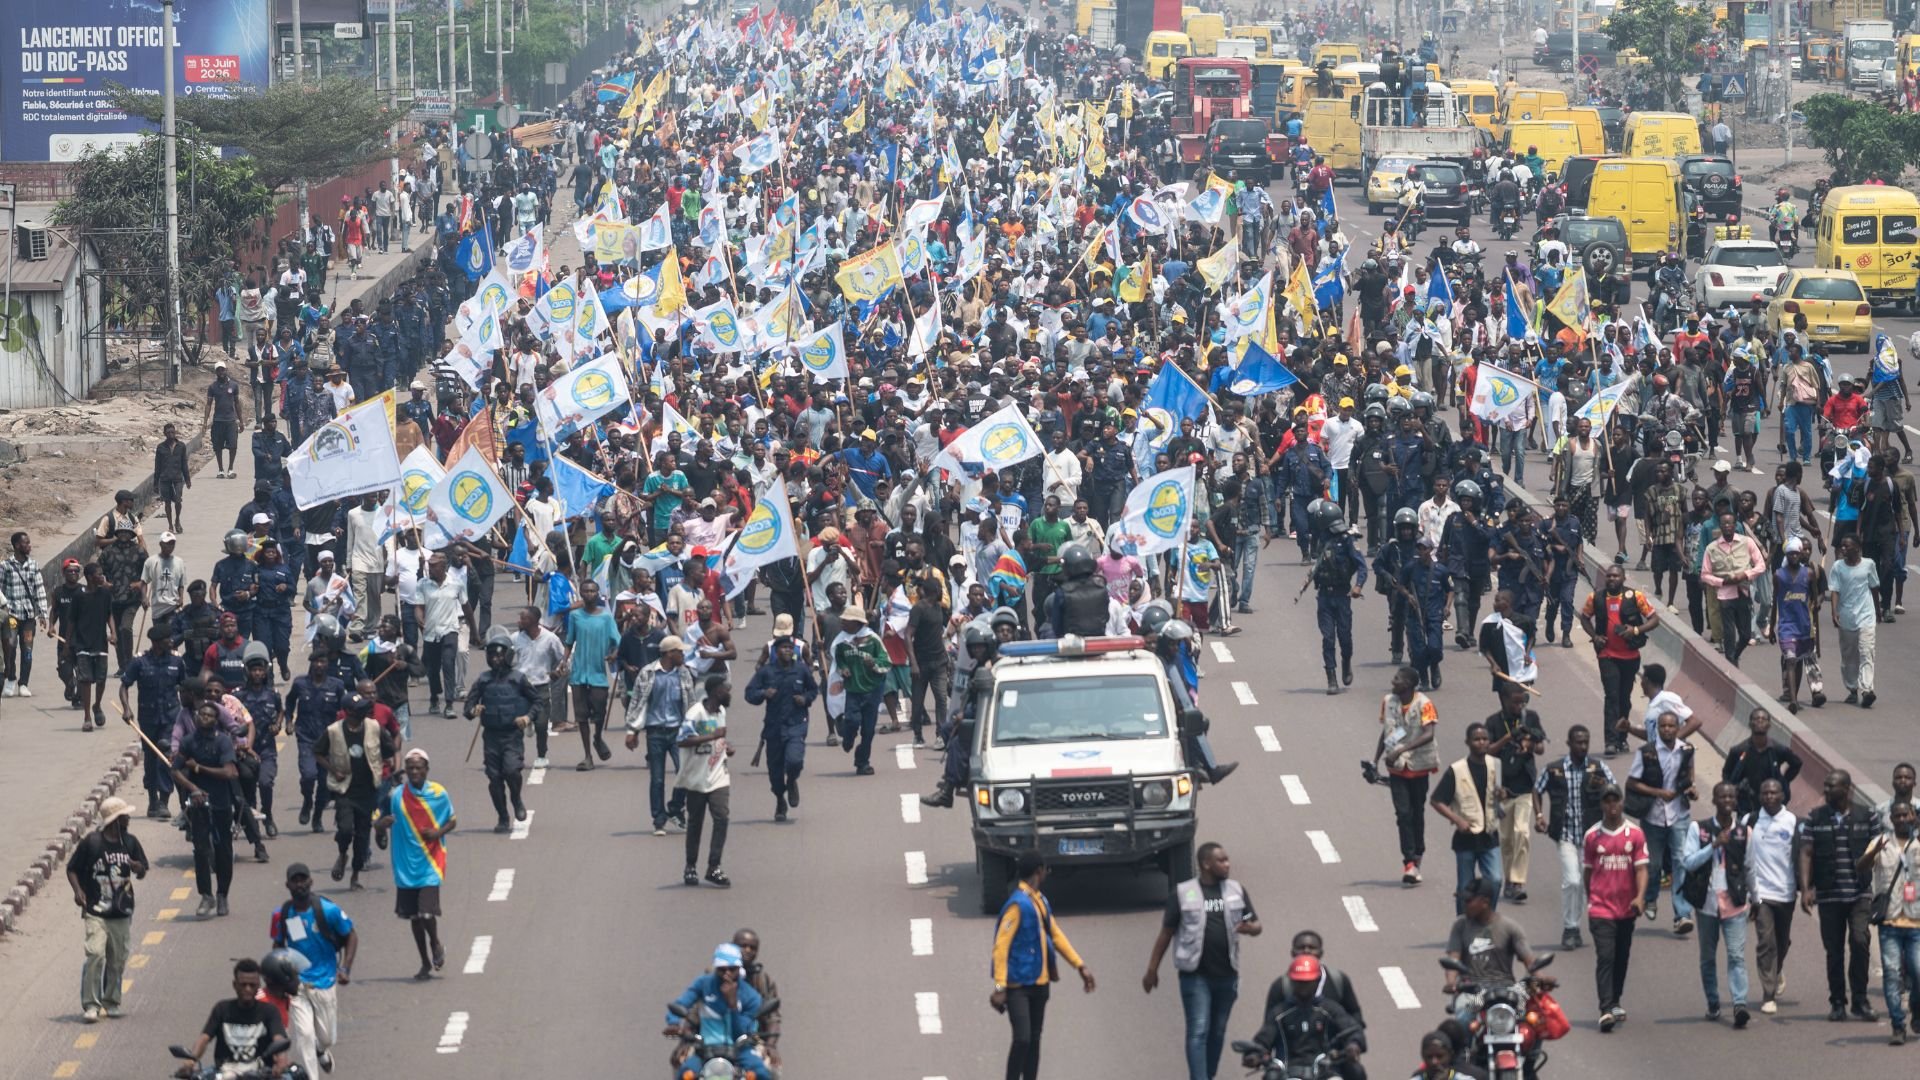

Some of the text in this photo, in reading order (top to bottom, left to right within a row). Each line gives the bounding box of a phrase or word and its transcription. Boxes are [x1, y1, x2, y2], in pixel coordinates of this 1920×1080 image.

[21, 26, 181, 48] LANCEMENT OFFICIL
[22, 50, 128, 72] DU RDC-PASS
[200, 58, 237, 68] 13 Juin
[200, 69, 231, 79] 2026
[23, 89, 45, 97] Notre
[46, 88, 88, 97] identifiant
[195, 85, 223, 93] Centre
[22, 101, 49, 110] Fiable,
[49, 100, 84, 109] Sécurisé
[85, 101, 94, 109] et
[23, 112, 128, 123] RDC totalement digitalisée
[1472, 160, 1482, 170] 13
[1062, 791, 1105, 802] TOYOTA
